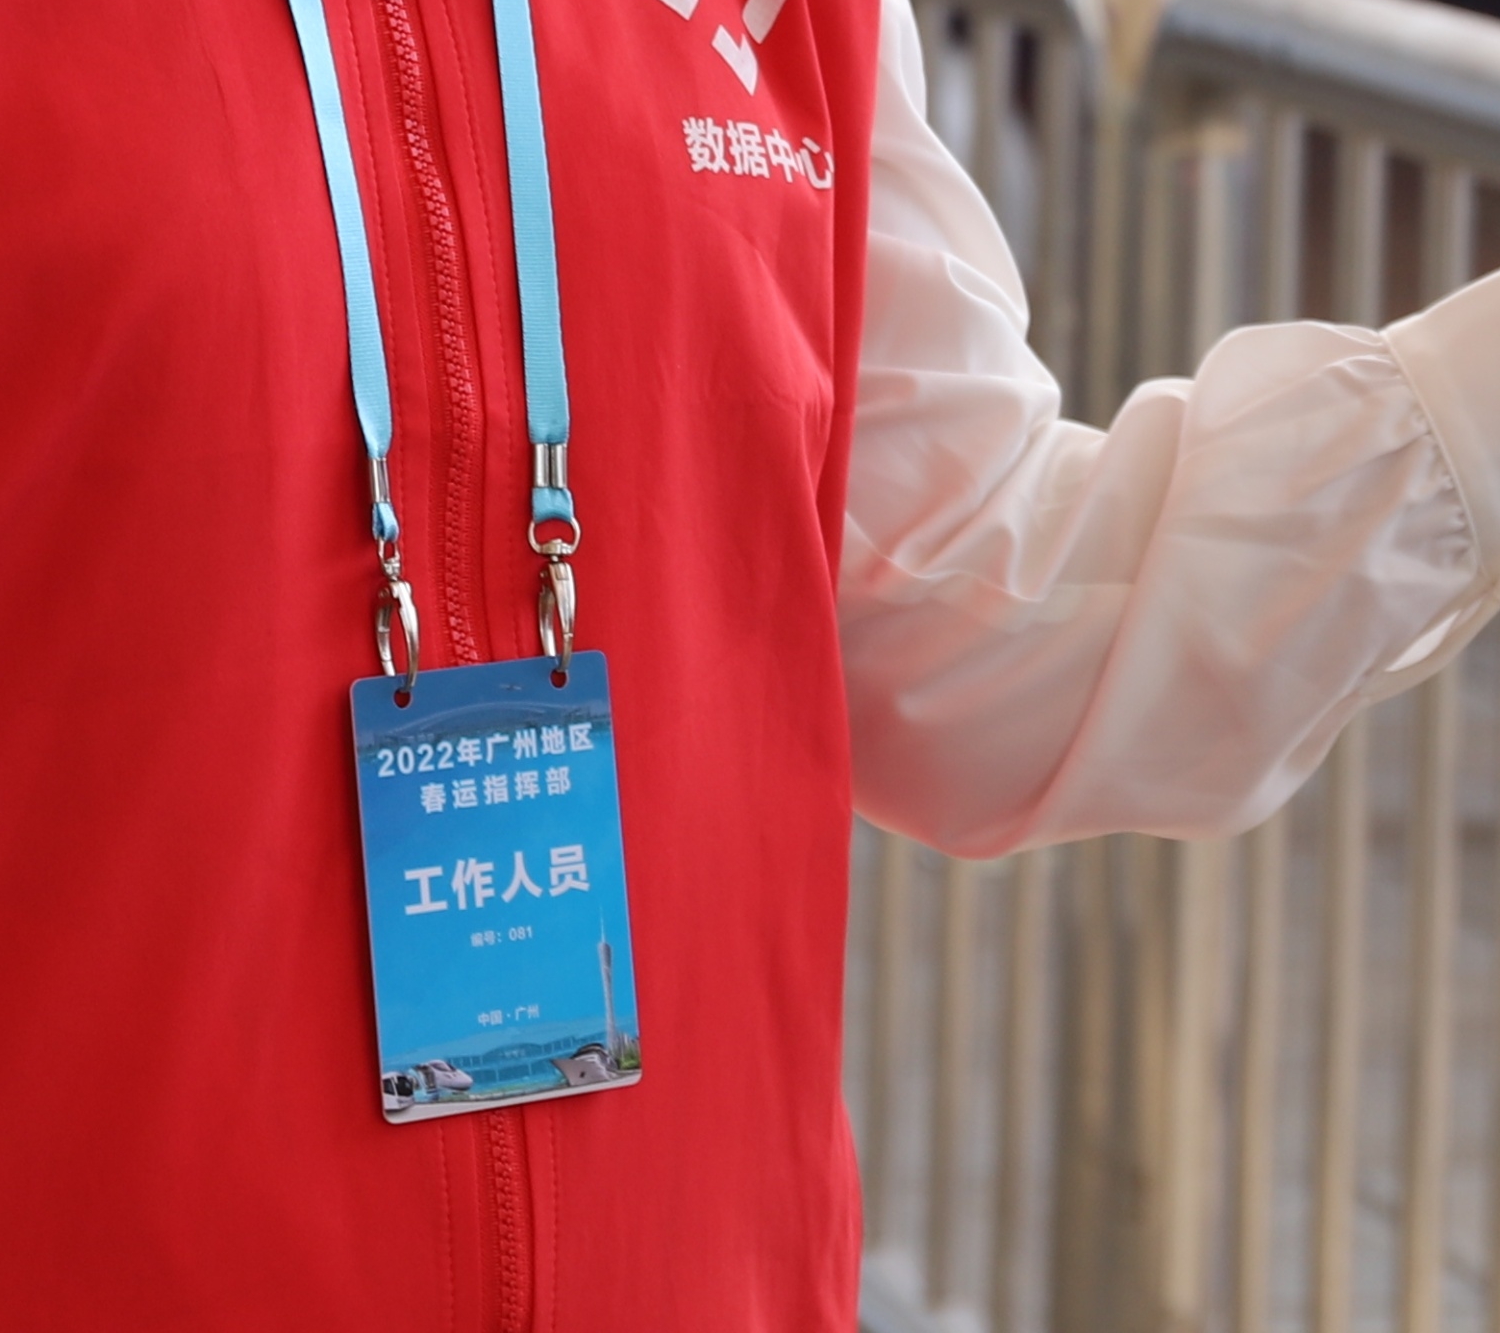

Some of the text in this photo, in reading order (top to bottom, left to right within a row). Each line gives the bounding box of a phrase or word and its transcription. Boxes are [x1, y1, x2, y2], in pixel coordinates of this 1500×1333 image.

[682, 117, 833, 189] 数据中心
[377, 722, 594, 778] 2022年广州地区
[420, 766, 572, 814] 春运指挥部
[404, 844, 590, 915] 工作人员
